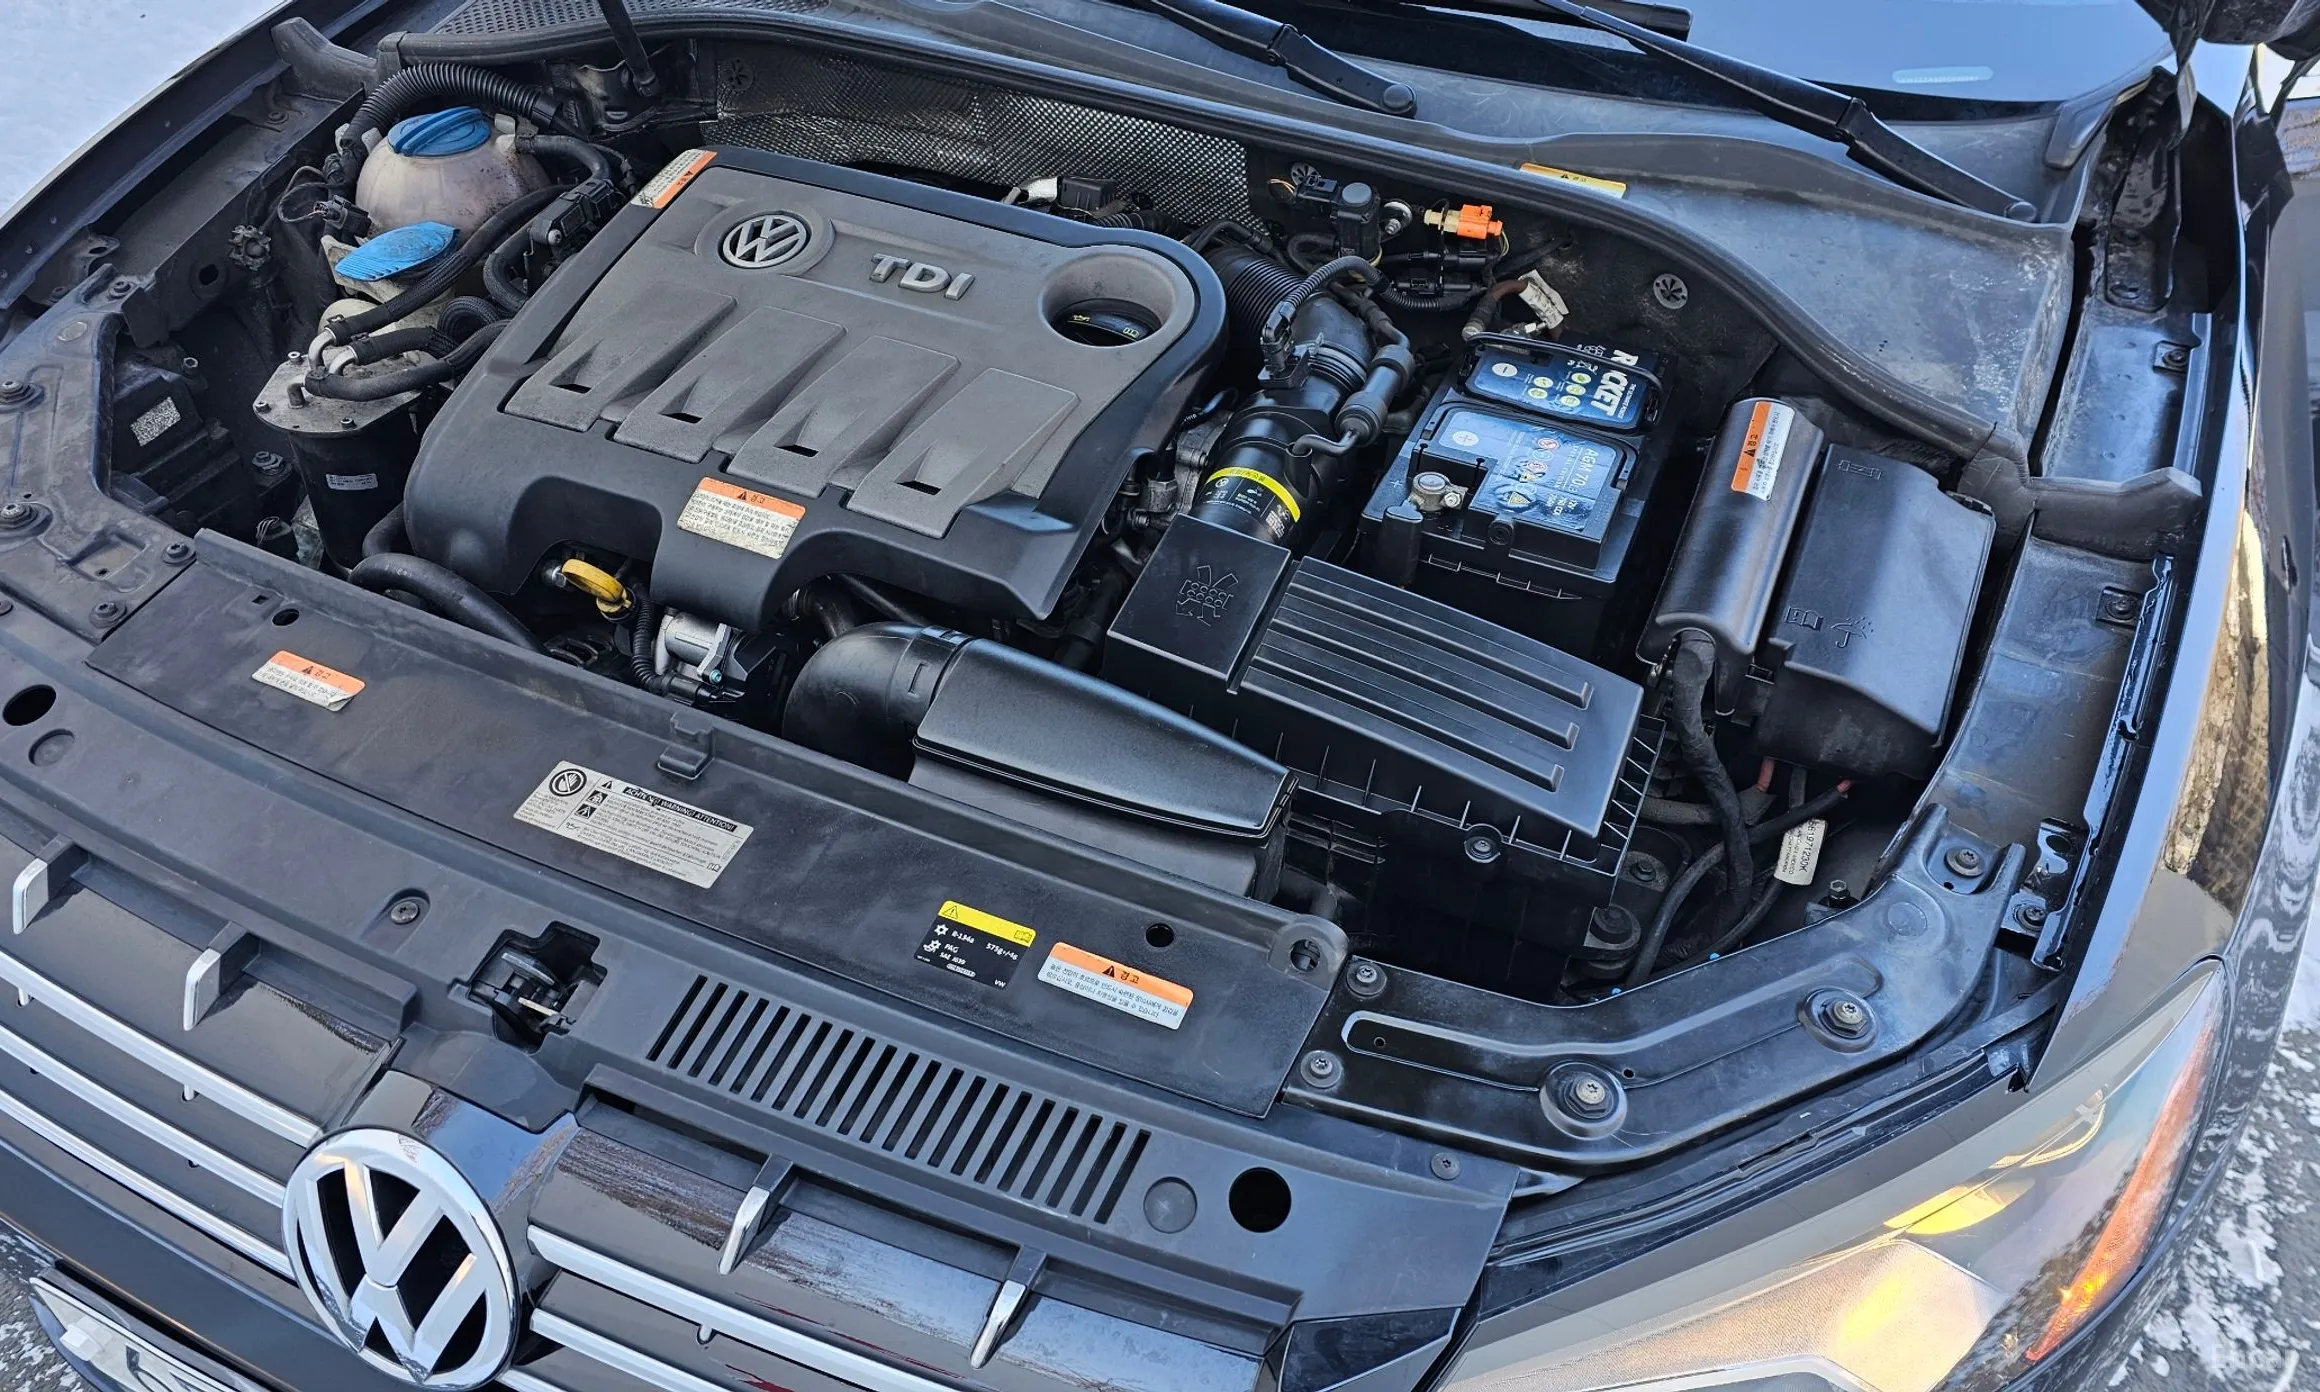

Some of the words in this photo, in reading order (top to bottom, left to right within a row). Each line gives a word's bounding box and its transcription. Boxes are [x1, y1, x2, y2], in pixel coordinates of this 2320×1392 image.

[869, 252, 976, 301] TDI
[1590, 349, 1639, 416] RCKET
[1579, 448, 1599, 472] AGM
[661, 799, 695, 817] WARNING!
[694, 811, 735, 831] ATTENTION!
[944, 943, 960, 953] PAG
[994, 979, 1006, 988] VW
[1118, 969, 1141, 985] 경고
